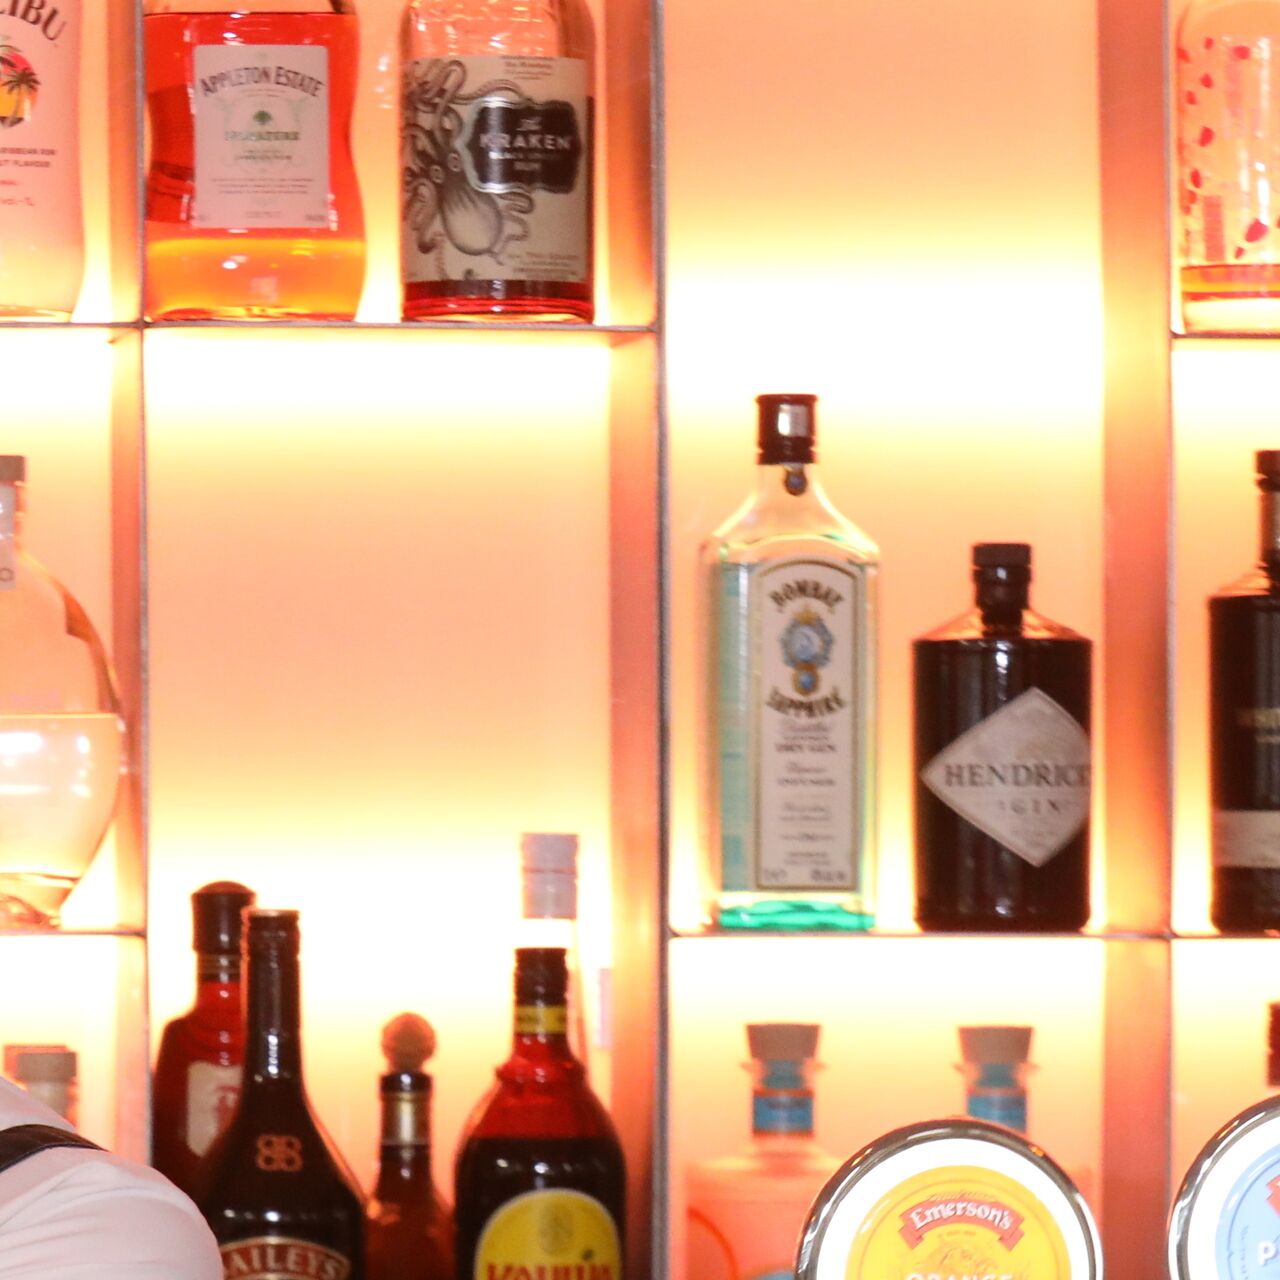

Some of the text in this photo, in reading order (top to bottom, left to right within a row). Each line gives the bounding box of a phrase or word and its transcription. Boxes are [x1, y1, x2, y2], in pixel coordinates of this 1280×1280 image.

[200, 66, 325, 97] APPLETON ESTATE
[480, 134, 571, 149] KRAKEN
[909, 1200, 1014, 1230] Emerson's
